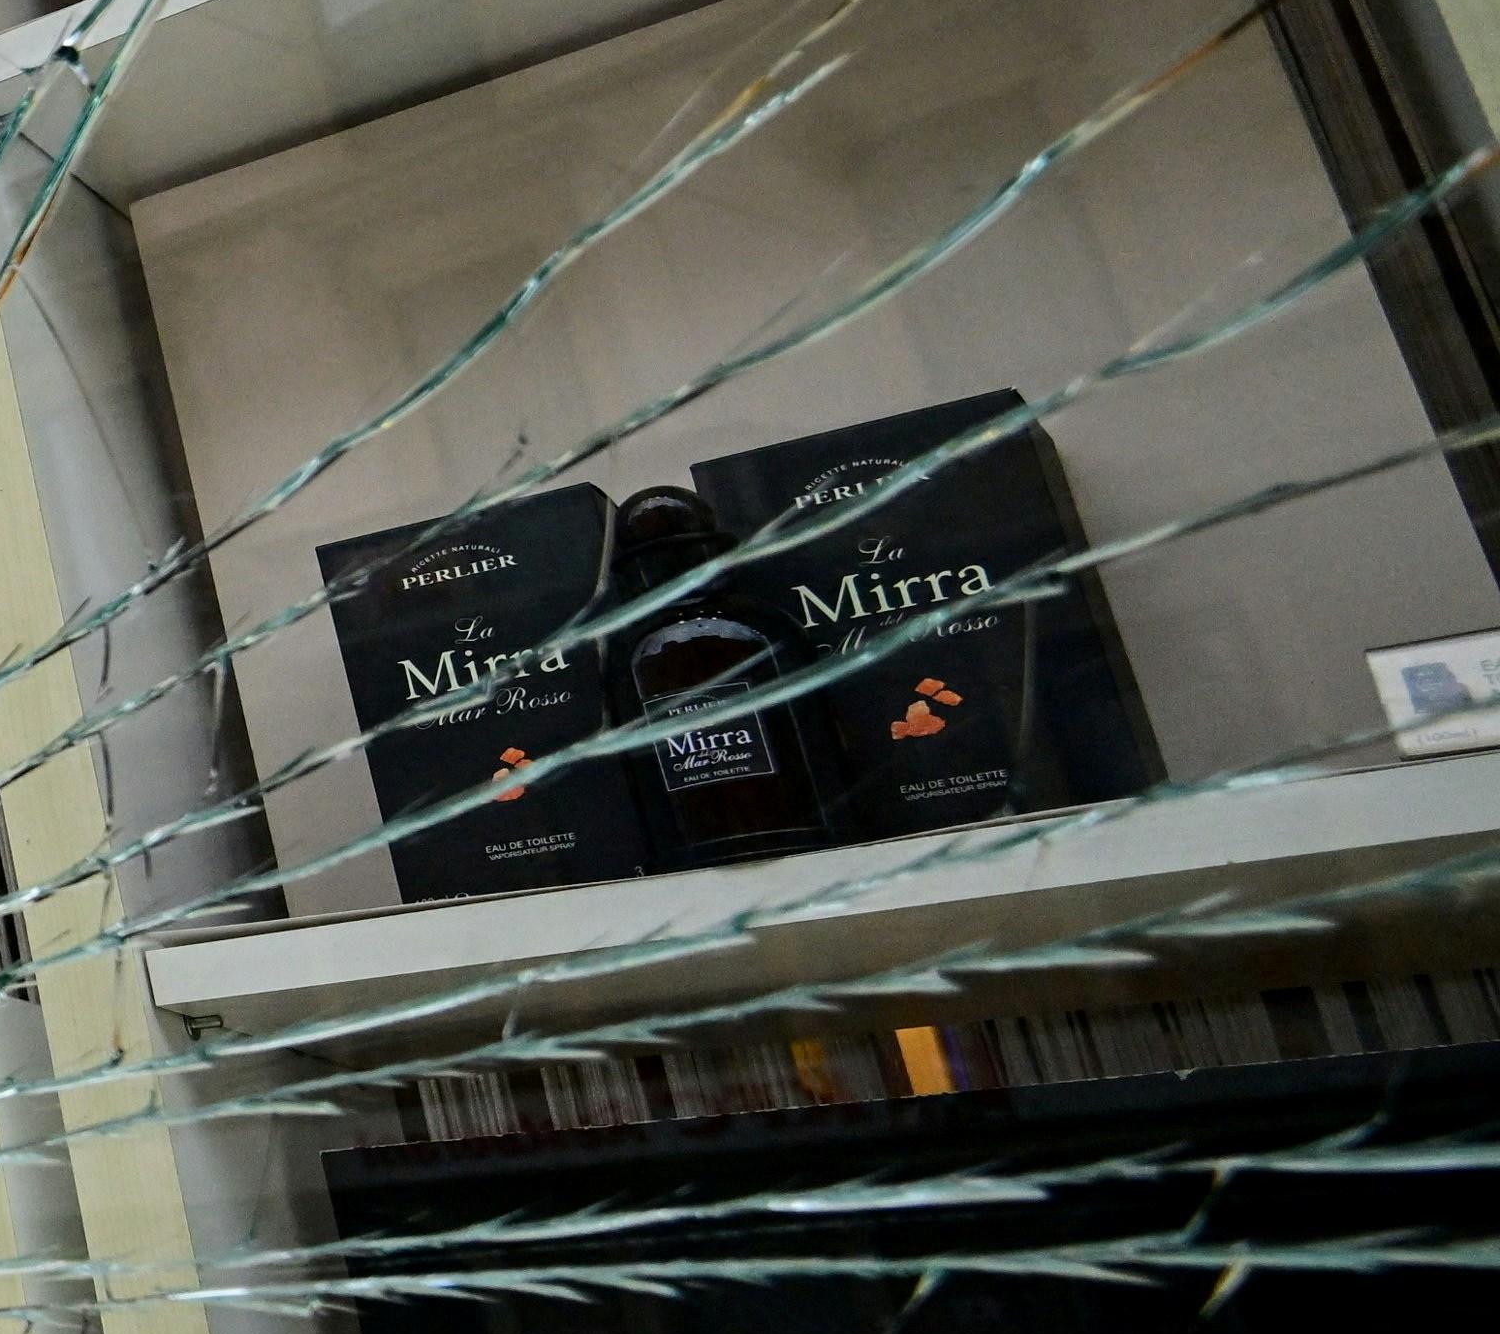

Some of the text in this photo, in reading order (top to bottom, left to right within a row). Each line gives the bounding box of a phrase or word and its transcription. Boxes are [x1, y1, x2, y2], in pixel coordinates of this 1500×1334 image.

[804, 463, 847, 491] RICETTE
[410, 543, 501, 574] RICETTE NATURALI
[857, 535, 908, 567] La
[401, 554, 519, 591] PERLIER
[790, 564, 996, 629] Mirra
[453, 614, 498, 646] La
[397, 641, 571, 701] Mirra
[496, 686, 573, 716] Rosso
[665, 728, 753, 758] Mirra
[673, 754, 710, 772] Mar
[710, 748, 752, 765] Rosso
[684, 774, 699, 783] EAU
[713, 765, 751, 777] TOILETTE
[900, 769, 1008, 795] EAU DE TOILETTE
[976, 778, 1008, 793] SPRAY
[484, 831, 576, 854] EAU DE TOILETTE
[548, 840, 576, 854] SPRAY
